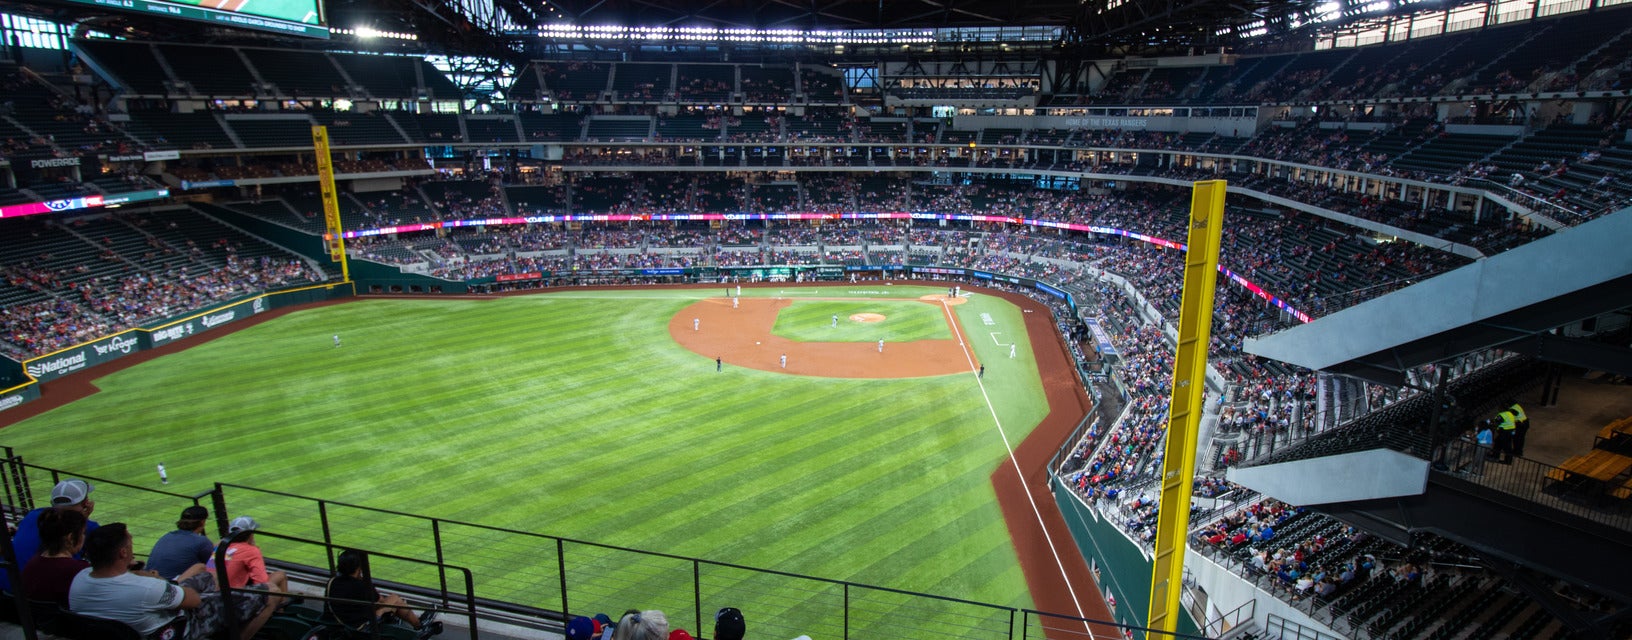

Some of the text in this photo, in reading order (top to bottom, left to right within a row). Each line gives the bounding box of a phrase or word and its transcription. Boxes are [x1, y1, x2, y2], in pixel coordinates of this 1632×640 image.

[1065, 118, 1080, 126] HOME
[1102, 119, 1119, 127] TEXAS
[1120, 119, 1147, 127] RANGERS
[31, 157, 81, 168] POWERADE
[108, 336, 138, 353] Kroger
[41, 351, 87, 374] National
[69, 362, 86, 372] Rental
